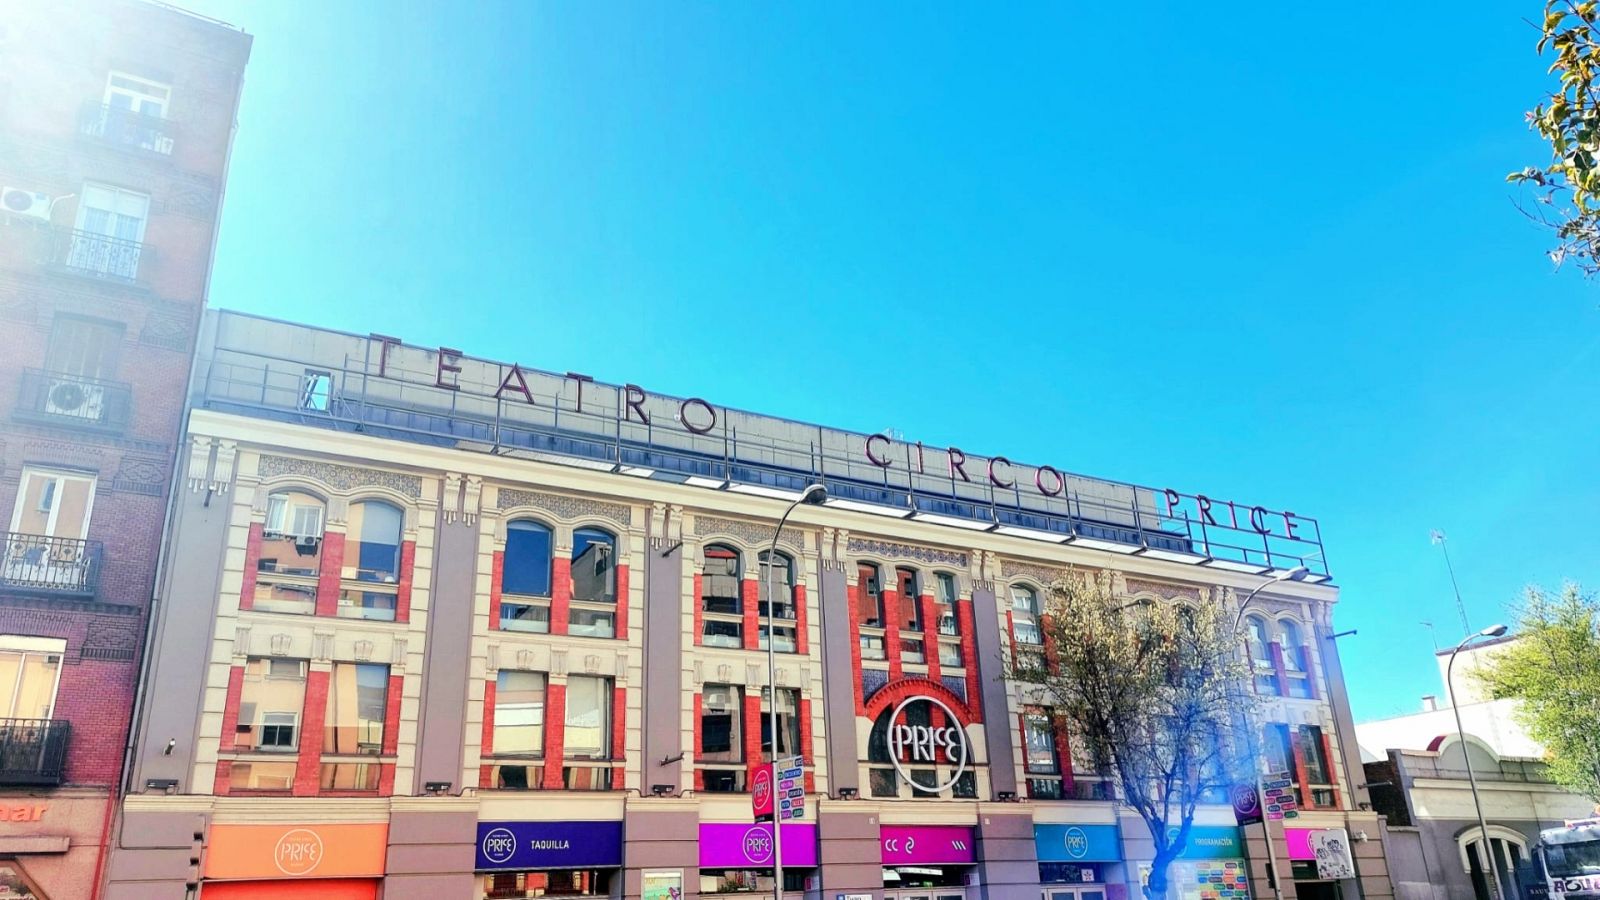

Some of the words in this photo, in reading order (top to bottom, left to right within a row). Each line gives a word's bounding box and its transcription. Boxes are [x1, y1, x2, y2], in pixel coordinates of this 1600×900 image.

[370, 333, 717, 435] TEATRO
[865, 433, 1063, 497] CIRCO
[1165, 488, 1300, 541] PRICE
[896, 724, 958, 762] PRICE
[487, 838, 512, 852] PRICE
[531, 839, 570, 850] TAQUILLA
[746, 837, 770, 852] PRICE
[1194, 836, 1233, 846] PROGRAMACIÓN
[281, 843, 317, 861] PRICE
